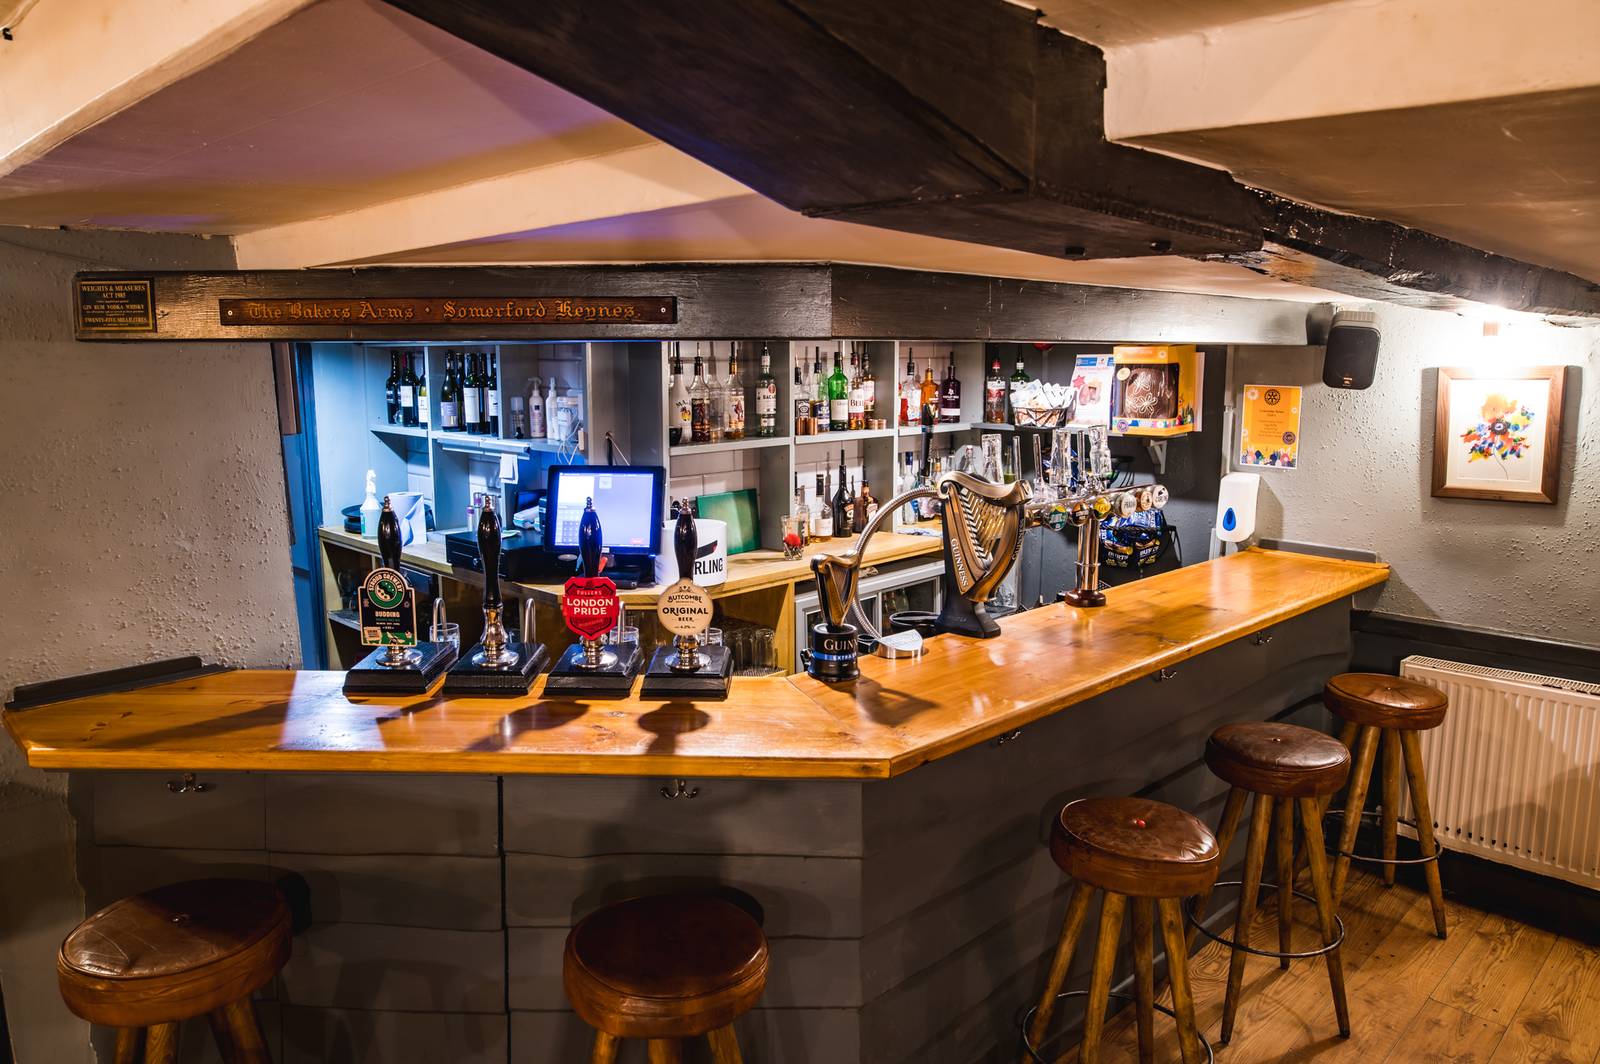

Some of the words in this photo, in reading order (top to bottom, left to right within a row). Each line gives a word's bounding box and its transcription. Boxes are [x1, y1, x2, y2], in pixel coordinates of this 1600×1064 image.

[247, 302, 282, 319] The
[287, 302, 350, 319] Bakers
[359, 301, 414, 319] Arms
[443, 300, 546, 319] Somerford
[951, 538, 968, 587] GUINNESS
[567, 598, 613, 606] LONDON
[667, 594, 703, 603] BUTCOMBE
[573, 607, 607, 615] PRIDE
[662, 607, 709, 616] ORIGINAL
